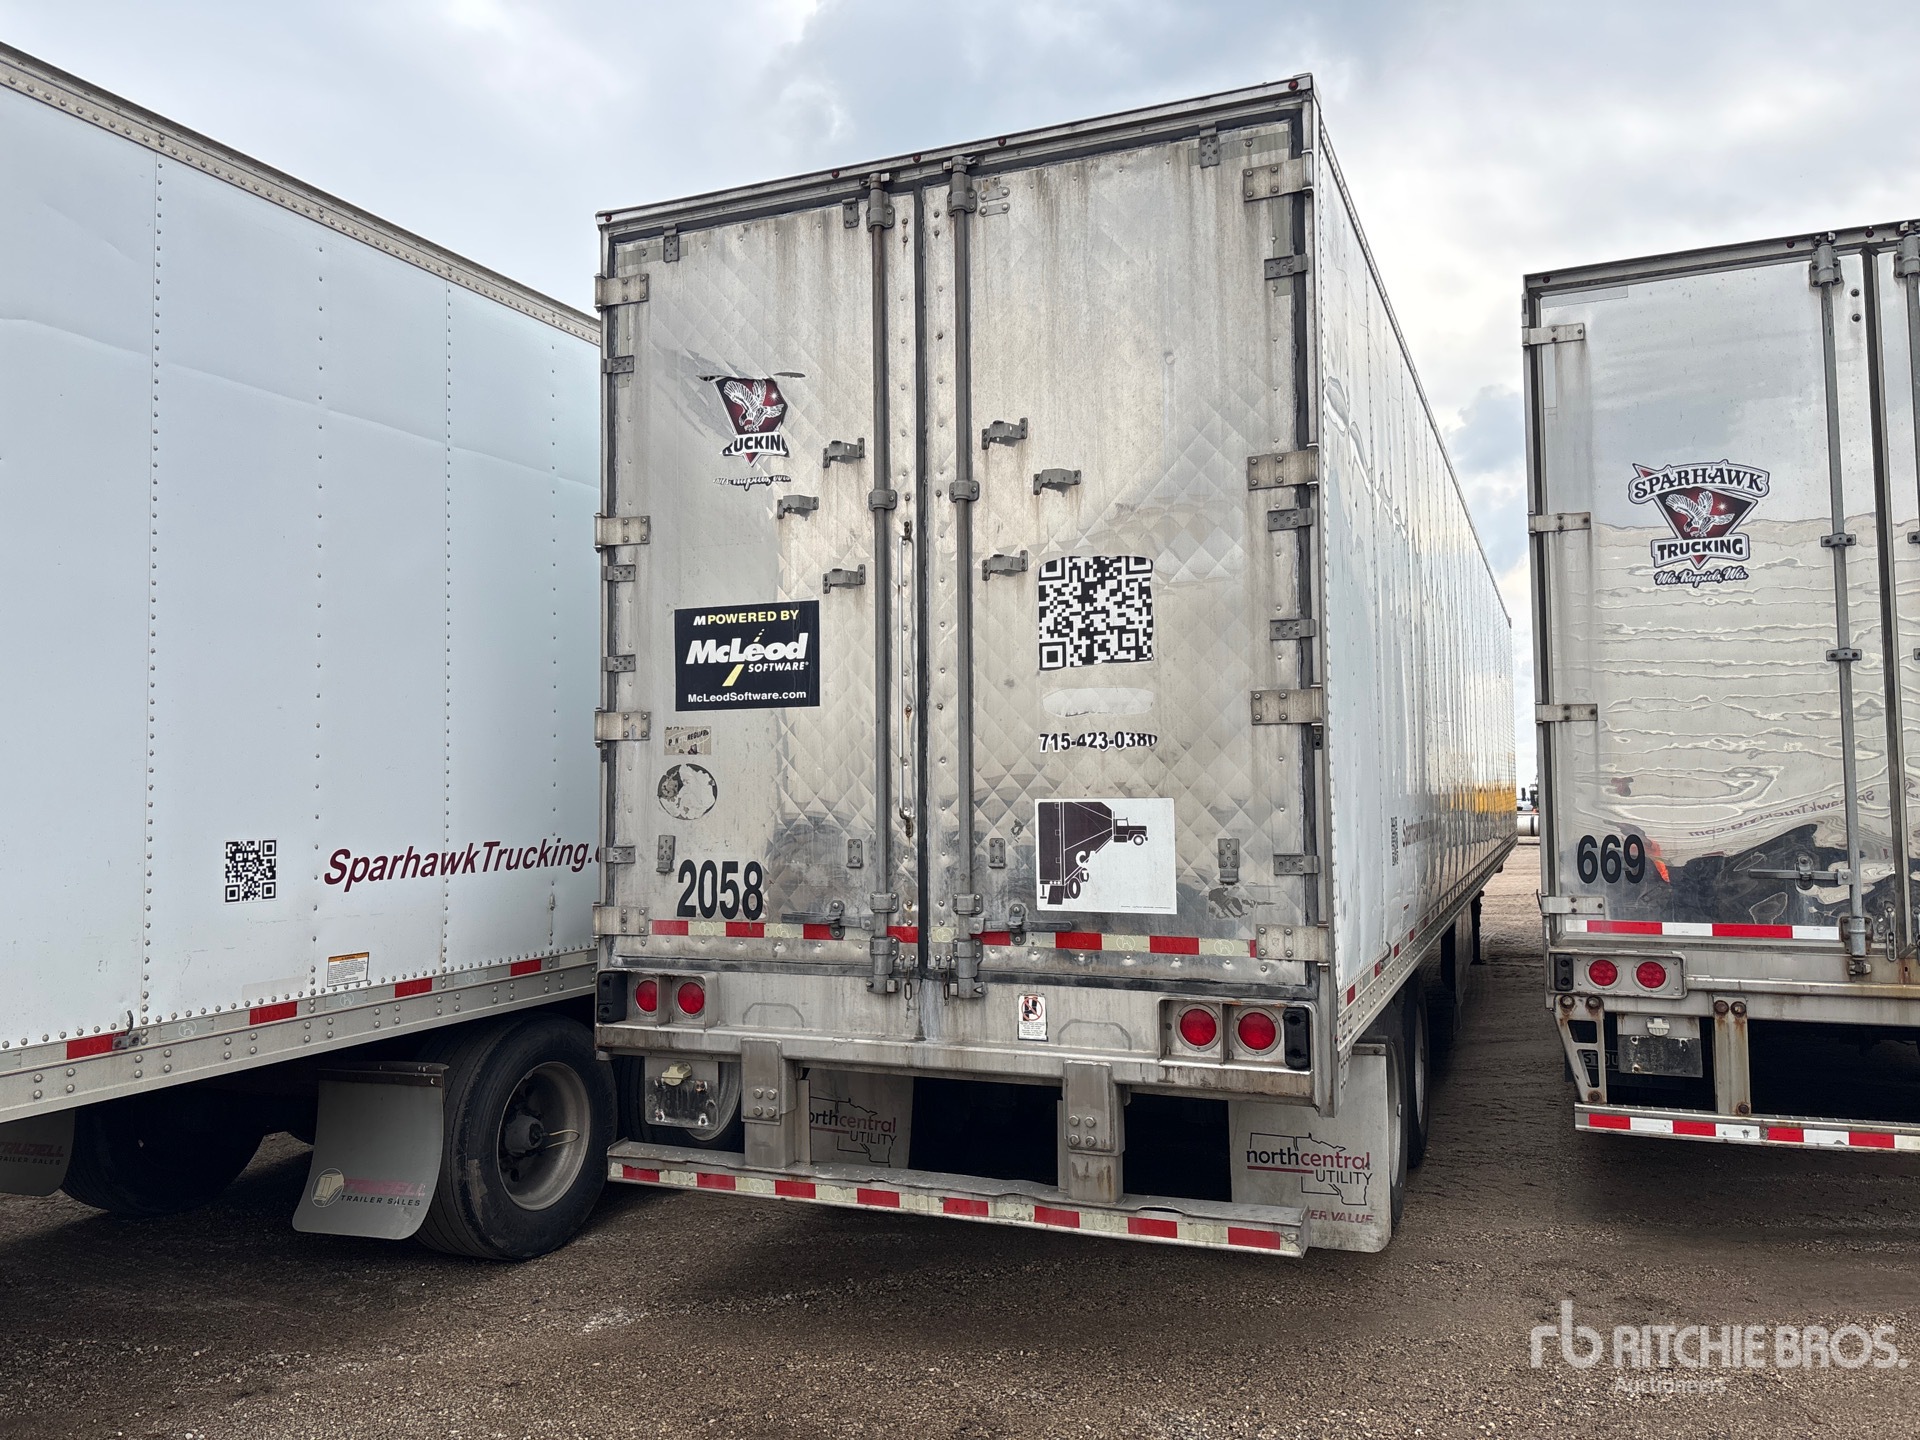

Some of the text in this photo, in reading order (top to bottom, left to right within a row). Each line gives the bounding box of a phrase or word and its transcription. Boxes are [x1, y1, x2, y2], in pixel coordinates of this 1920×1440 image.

[1634, 467, 1764, 499] SPARHAWK
[1657, 538, 1744, 562] TRUCKING
[1655, 570, 1679, 586] Wis.
[1723, 566, 1749, 581] Wis.
[780, 609, 800, 621] BY
[685, 632, 809, 665] McLeod
[688, 690, 807, 703] McLeodSoftware.com
[1577, 834, 1646, 884] 669
[676, 859, 763, 921] 2058
[849, 1130, 898, 1146] UTILITY
[1246, 1147, 1370, 1171] northcentral
[1315, 1170, 1373, 1186] UTILITY
[341, 1194, 421, 1206] TRAILER SALES
[1331, 1211, 1375, 1224] VALUE
